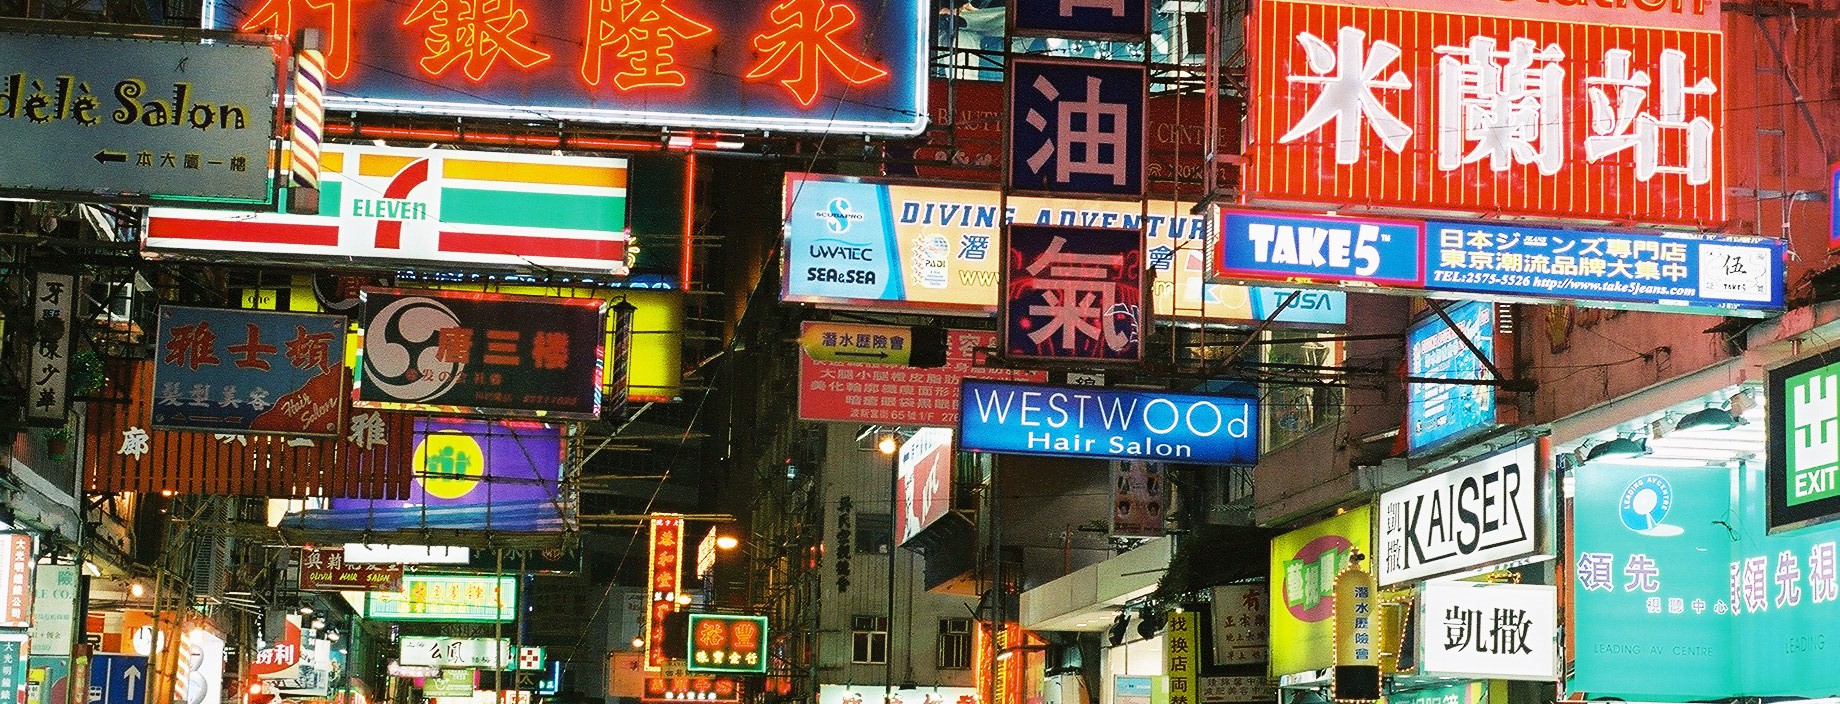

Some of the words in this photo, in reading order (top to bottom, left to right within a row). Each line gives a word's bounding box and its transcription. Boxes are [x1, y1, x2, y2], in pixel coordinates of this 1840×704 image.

[112, 78, 250, 131] Salon
[1280, 27, 1717, 185] 米蘭站
[1158, 123, 1227, 147] CENTE
[136, 151, 247, 172] 本大廈一樓
[816, 211, 863, 220] SCUBAPRO
[810, 245, 873, 261] UWATEC
[925, 259, 946, 268] PADI
[1440, 249, 1688, 282] 東京潮流品牌大集中
[807, 267, 876, 285] SEA&SEA
[1433, 270, 1531, 287] TEL:2575-5526
[1532, 276, 1696, 297] http://www.take5jeans.com
[165, 321, 336, 374] 雅士頓
[281, 393, 312, 417] Hair
[301, 397, 338, 430] Salon
[1028, 431, 1096, 452] Hair
[1109, 435, 1191, 457] Salon
[1795, 465, 1839, 498] EXIT
[1403, 463, 1528, 570] KAISER
[310, 572, 333, 581] OLIVIA
[367, 573, 390, 582] SALON
[1577, 552, 1660, 592] 領先
[1443, 605, 1534, 655] 凱撒
[1594, 644, 1641, 656] LEADING
[1650, 645, 1664, 656] AV
[1673, 646, 1713, 658] CENTRE
